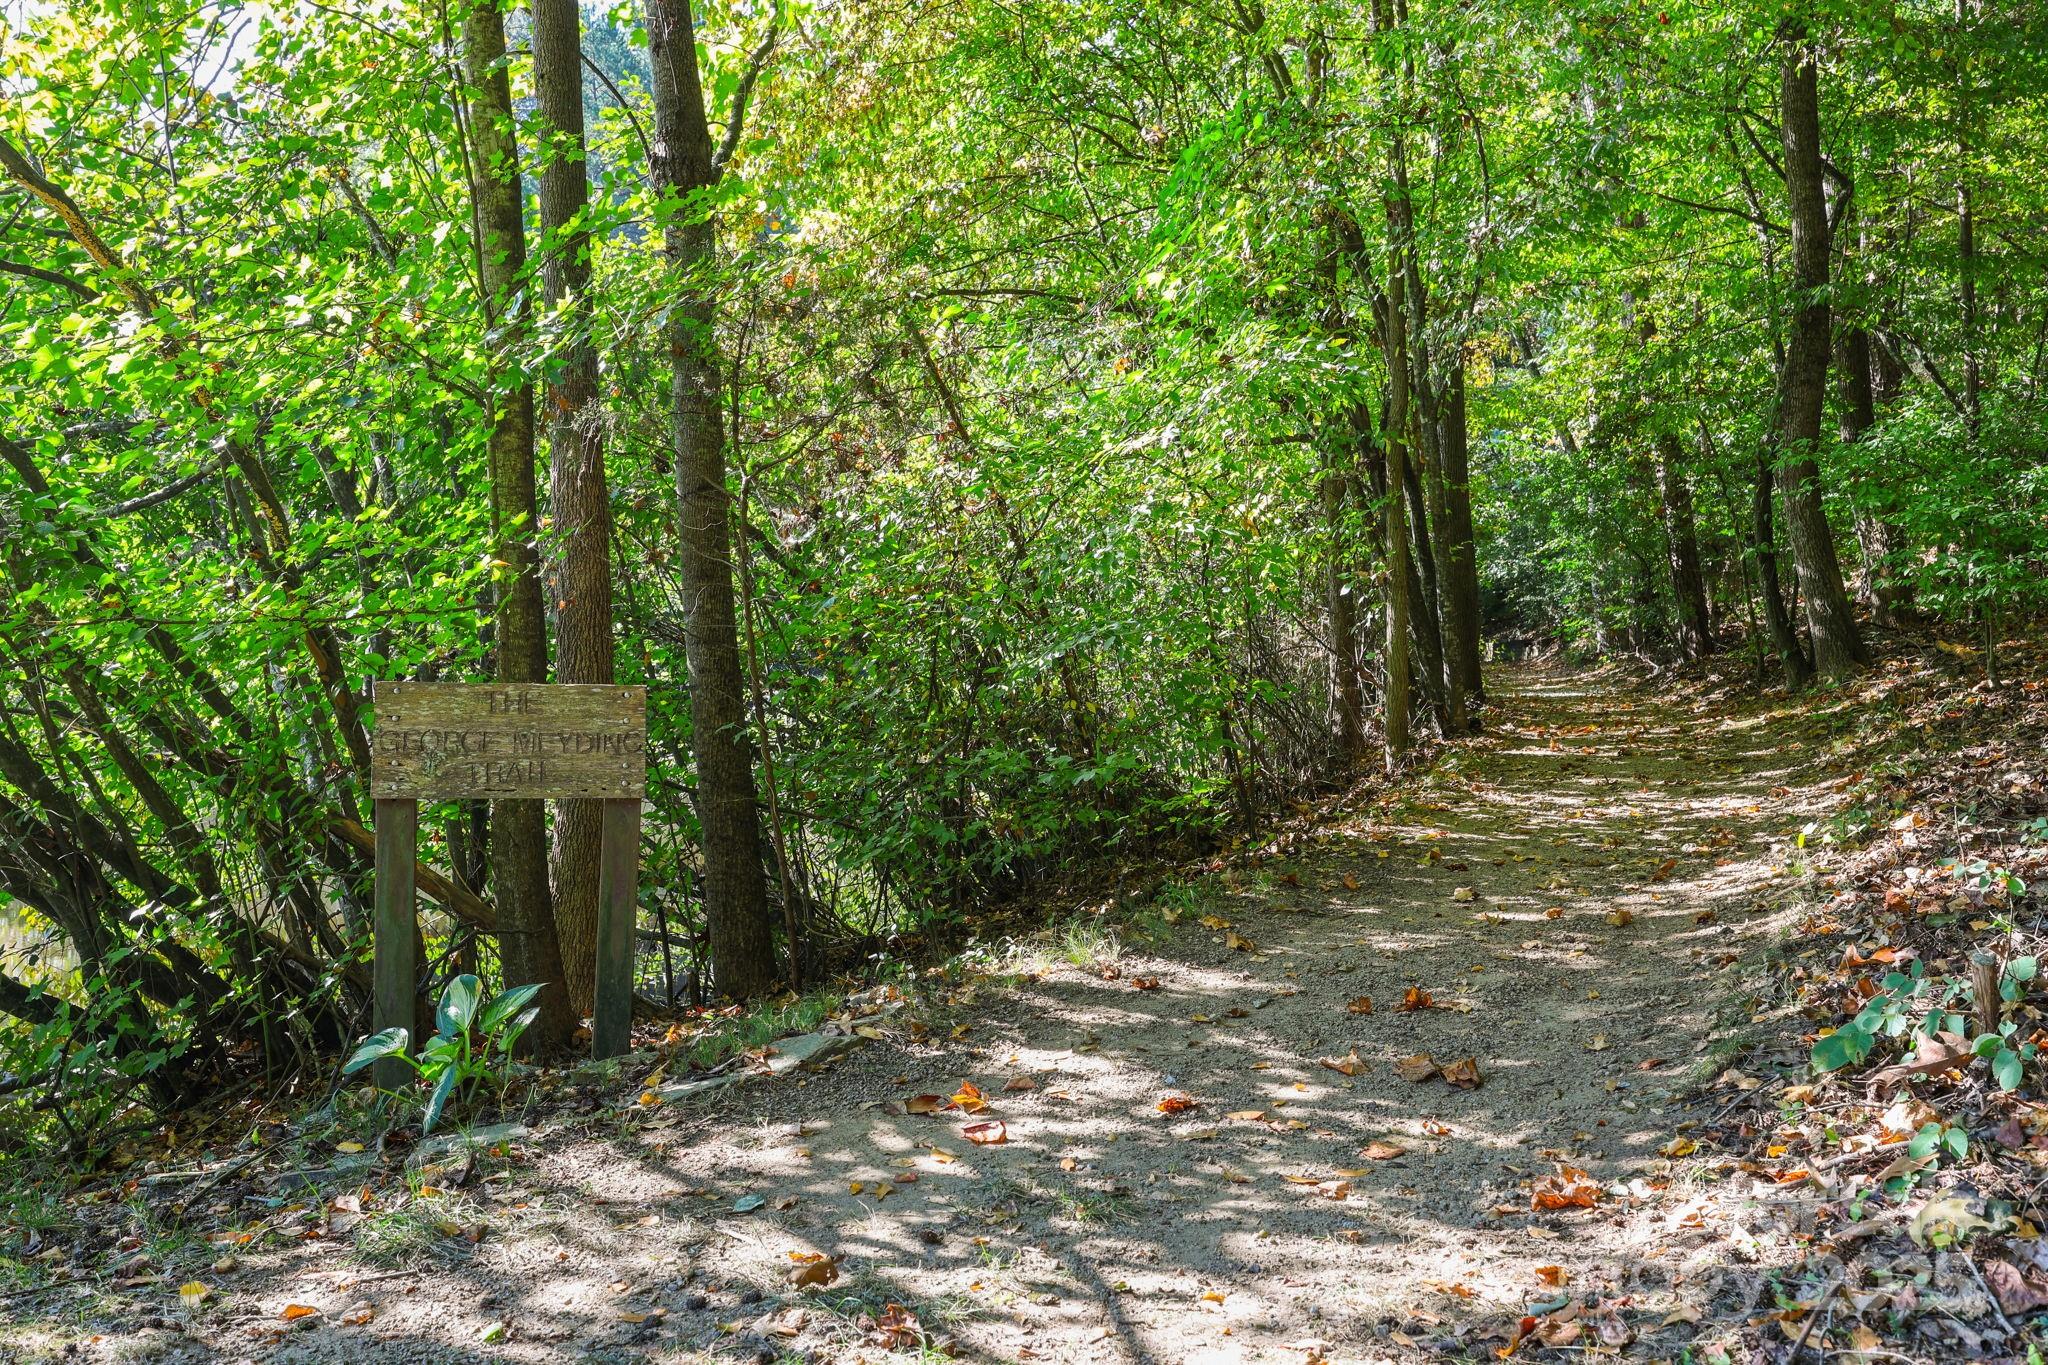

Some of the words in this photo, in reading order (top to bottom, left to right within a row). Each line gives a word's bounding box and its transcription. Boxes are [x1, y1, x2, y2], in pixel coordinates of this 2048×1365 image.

[484, 690, 542, 715] THE
[379, 729, 501, 753] GEORGE
[512, 731, 643, 754] MEYDING
[464, 761, 552, 784] TRAIL
